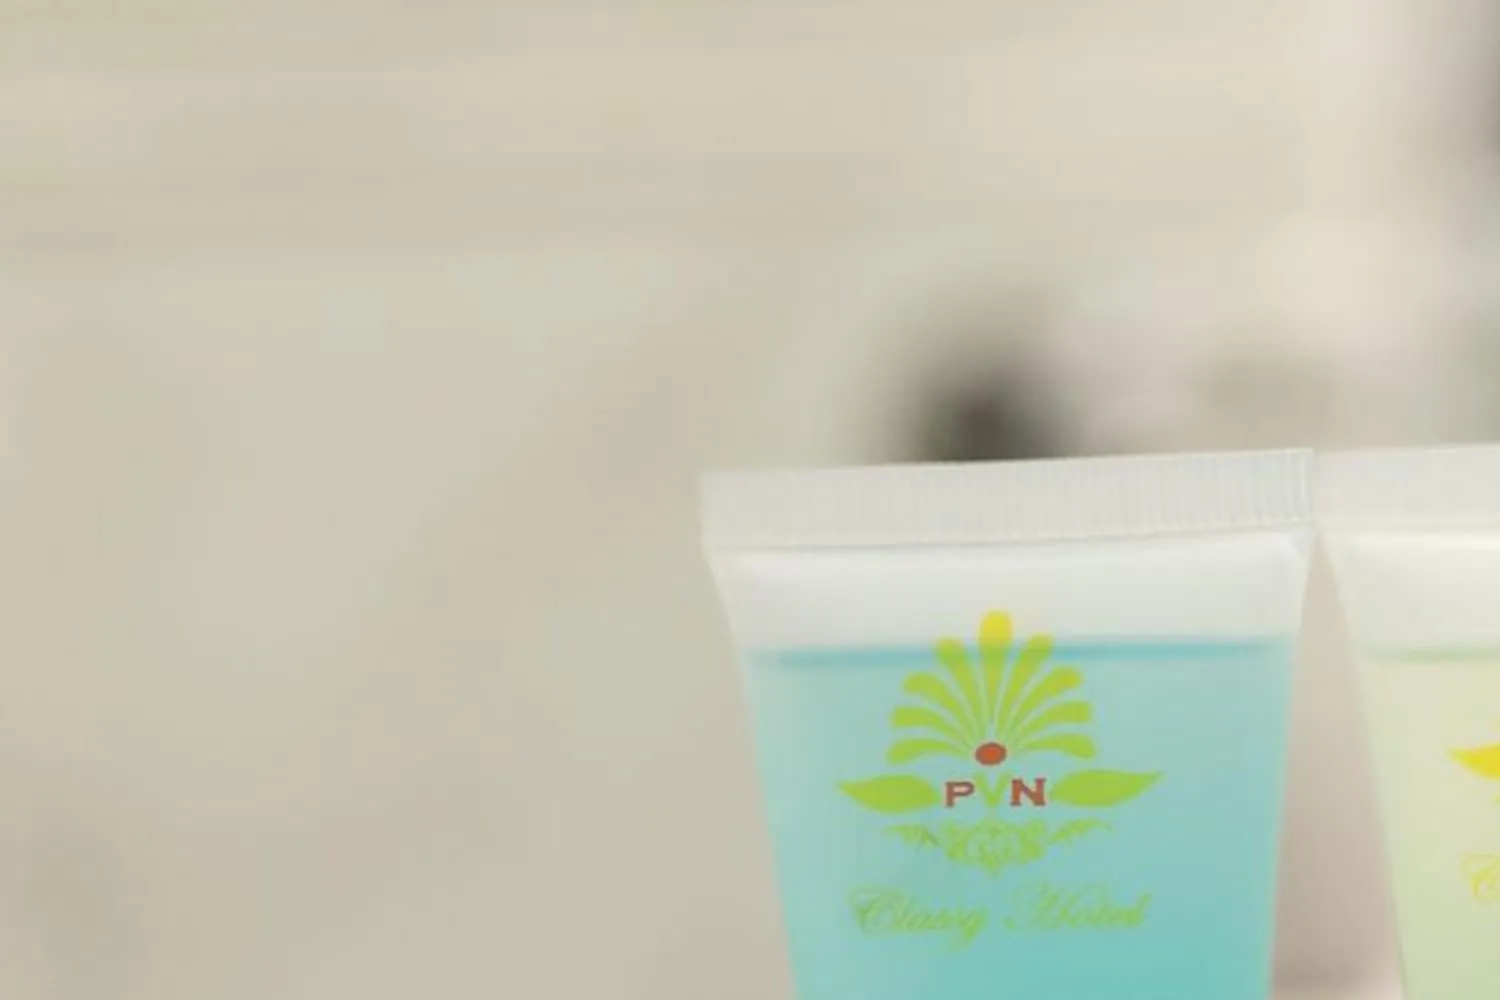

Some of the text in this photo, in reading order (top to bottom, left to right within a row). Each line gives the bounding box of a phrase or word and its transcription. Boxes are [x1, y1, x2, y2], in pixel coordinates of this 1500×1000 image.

[944, 773, 1048, 808] PVN
[848, 884, 1152, 948] Classy Hotel
